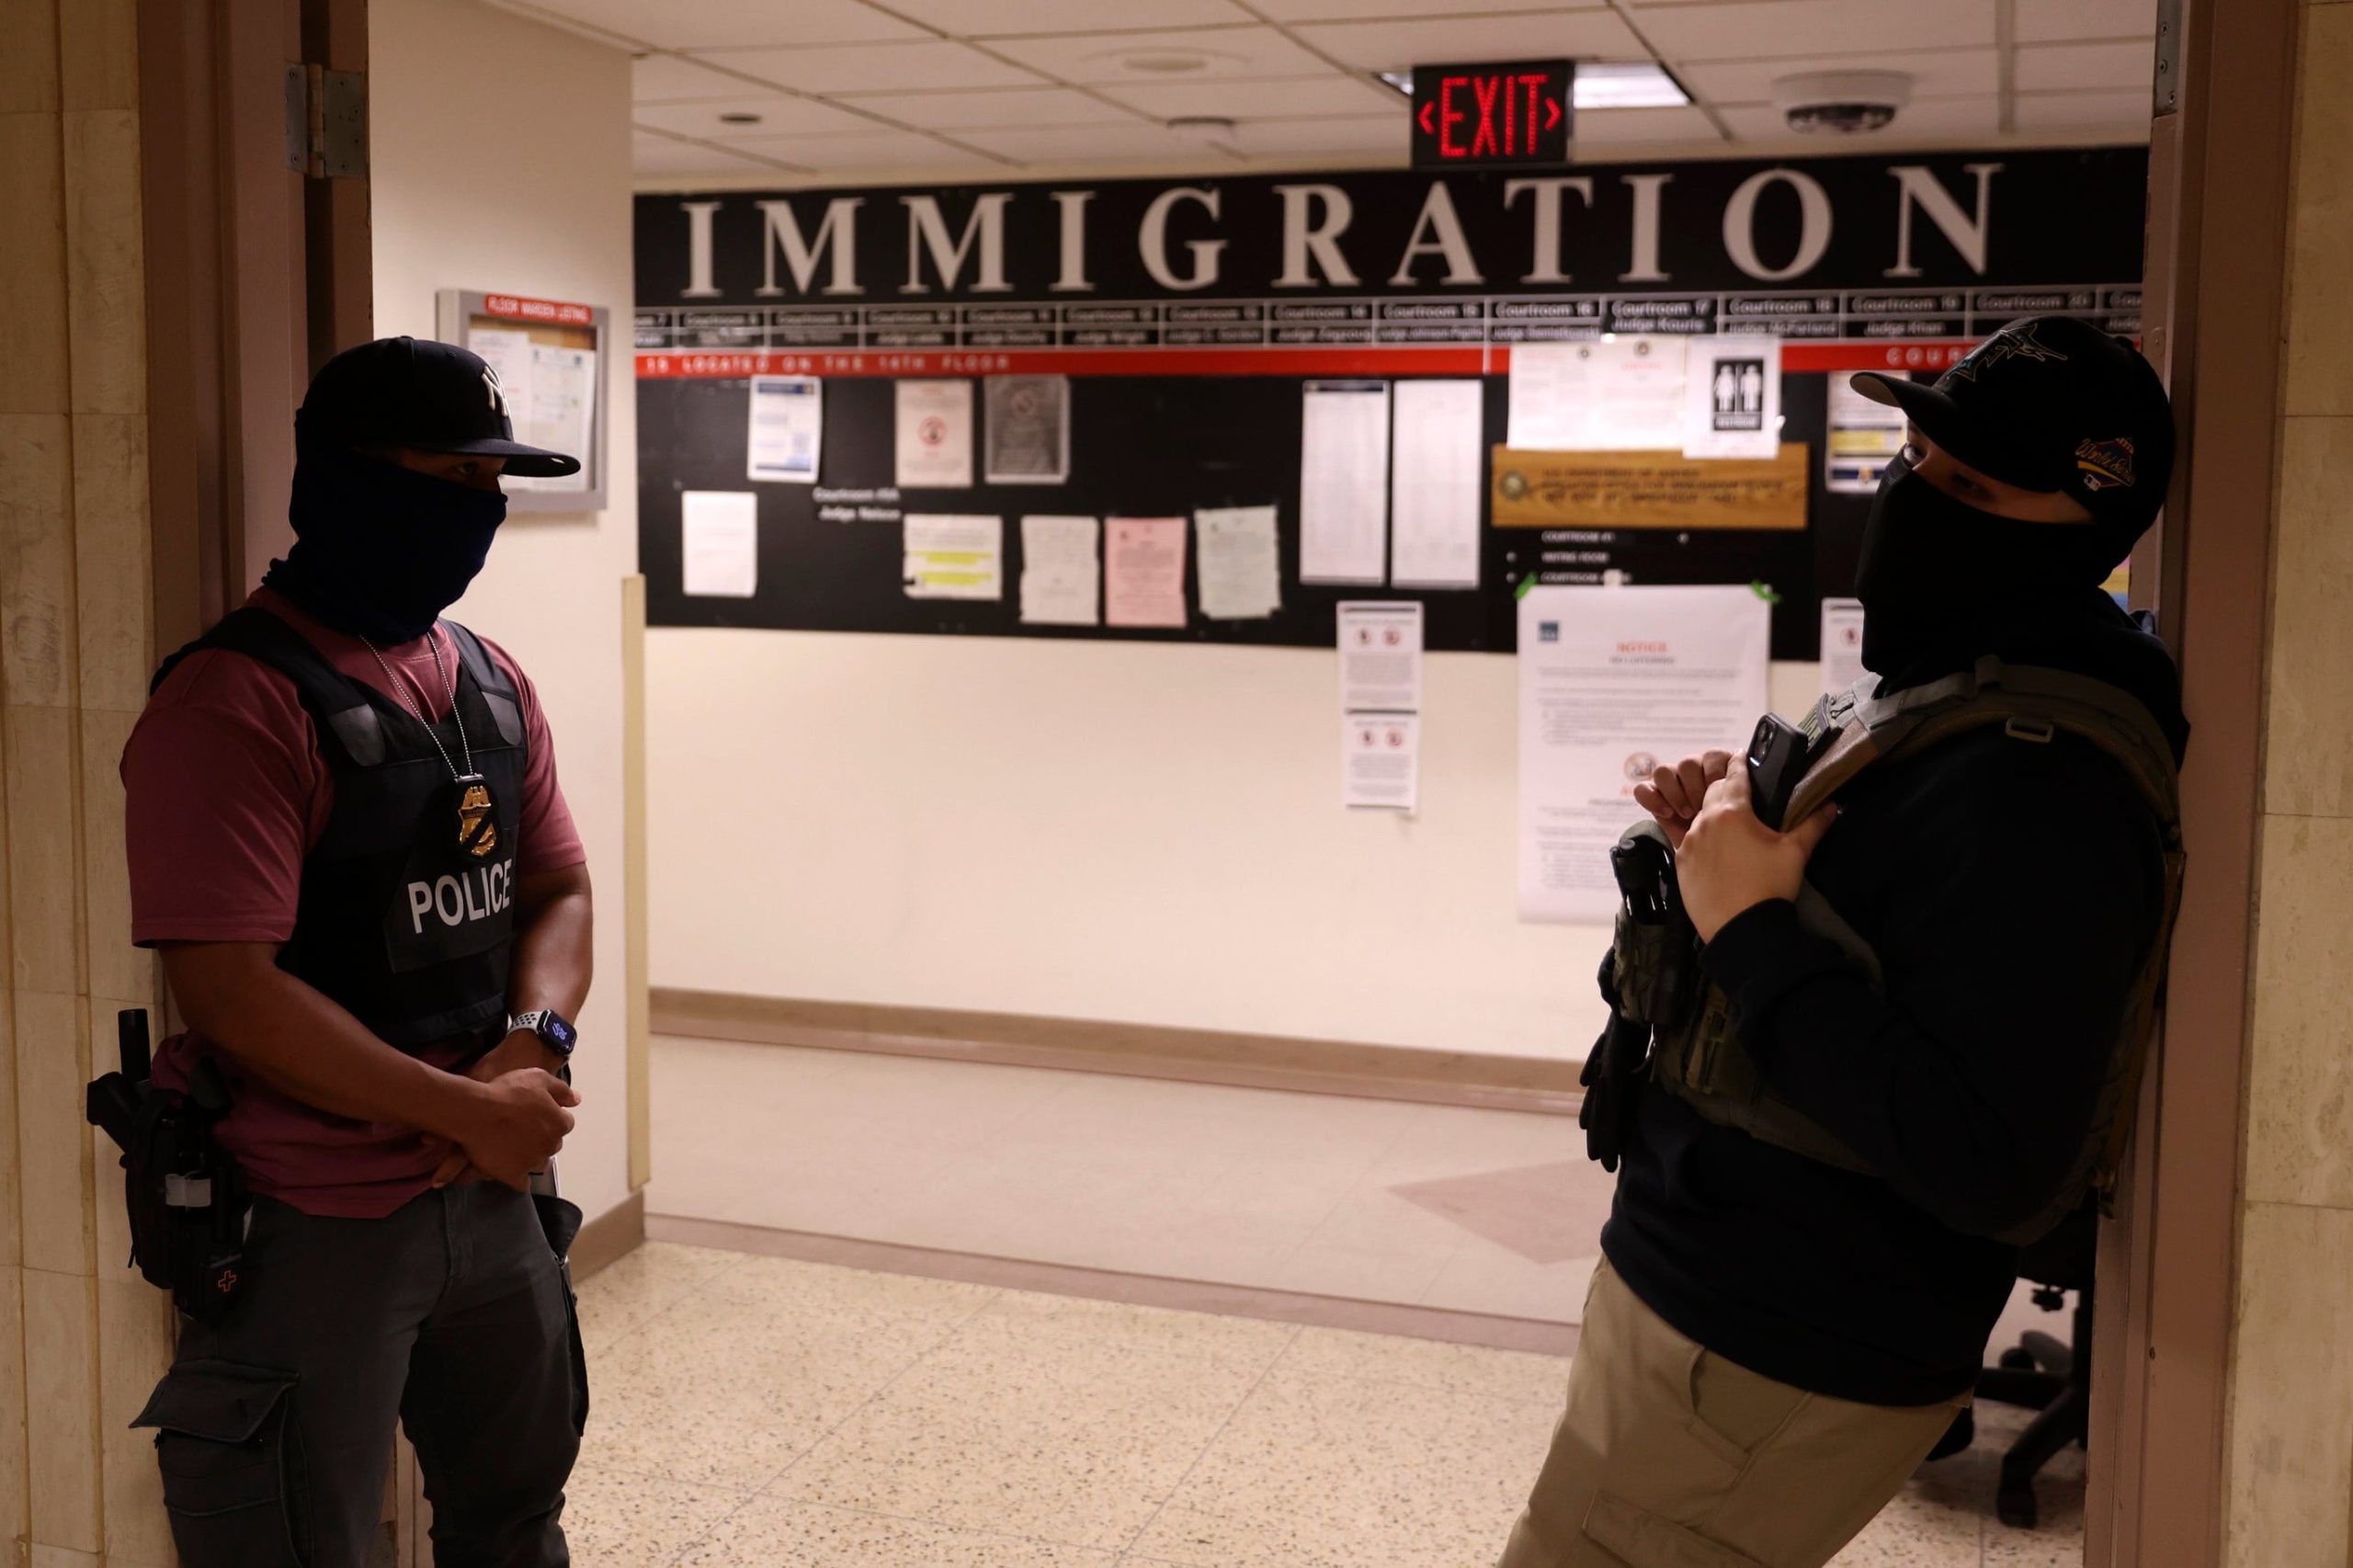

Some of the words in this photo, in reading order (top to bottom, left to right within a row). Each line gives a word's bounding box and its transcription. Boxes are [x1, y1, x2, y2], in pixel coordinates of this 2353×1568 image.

[1440, 74, 1549, 158] EXIT
[680, 162, 2004, 298] IMMIGRATION
[1383, 303, 1460, 319] Courtroom
[1495, 301, 1574, 318] Courtroom
[1611, 299, 1692, 318] Courtroom
[1730, 297, 1812, 314] Courtroom
[1852, 295, 1937, 313] Courtroom
[1977, 293, 2064, 311] Courtroom
[1611, 317, 1654, 333] Judge
[1863, 321, 1905, 337] Judge
[682, 354, 769, 374] LOCATED
[824, 353, 863, 373] THE
[942, 352, 1010, 371] FLOOR
[1617, 641, 1667, 653] NOTICE
[407, 858, 513, 935] POLICE
